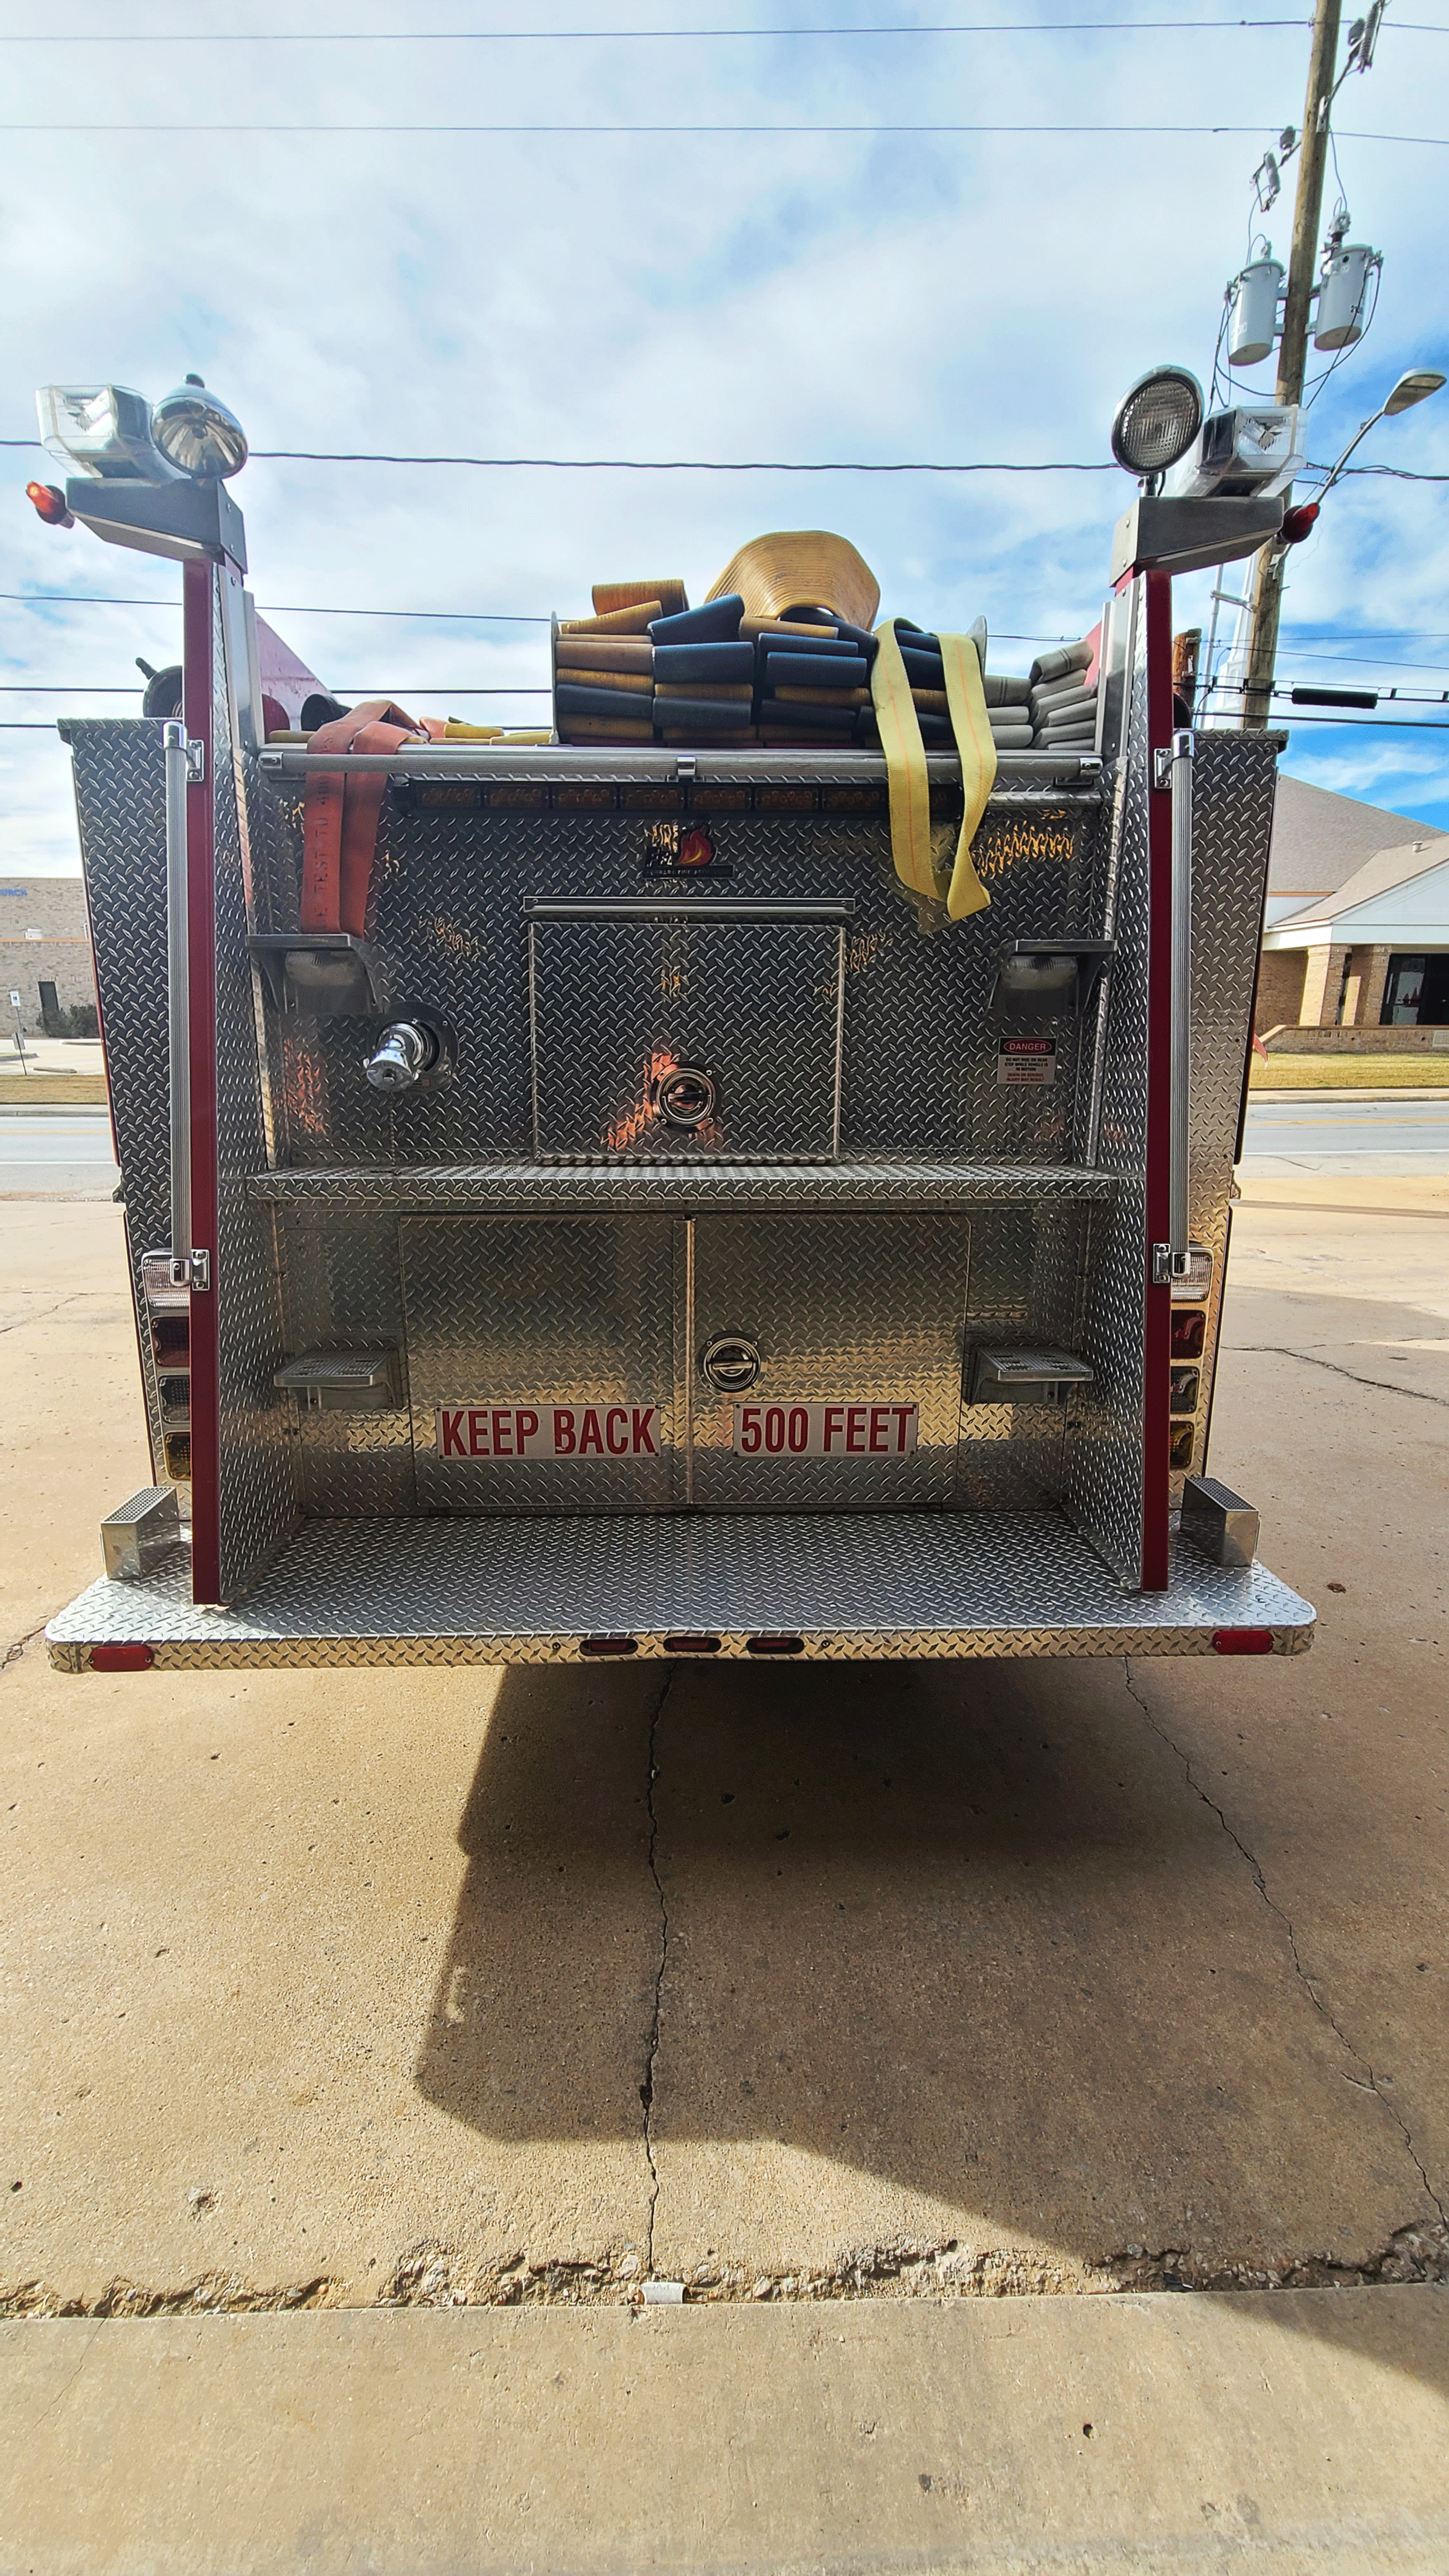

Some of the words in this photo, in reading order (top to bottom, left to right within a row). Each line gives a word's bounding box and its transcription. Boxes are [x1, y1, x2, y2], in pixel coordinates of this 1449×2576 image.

[316, 775, 331, 806] 400
[313, 851, 328, 893] TEST
[441, 1409, 539, 1456] KEEP
[553, 1407, 657, 1456] BACK
[741, 1407, 809, 1453] 500
[823, 1407, 915, 1453] FEET
